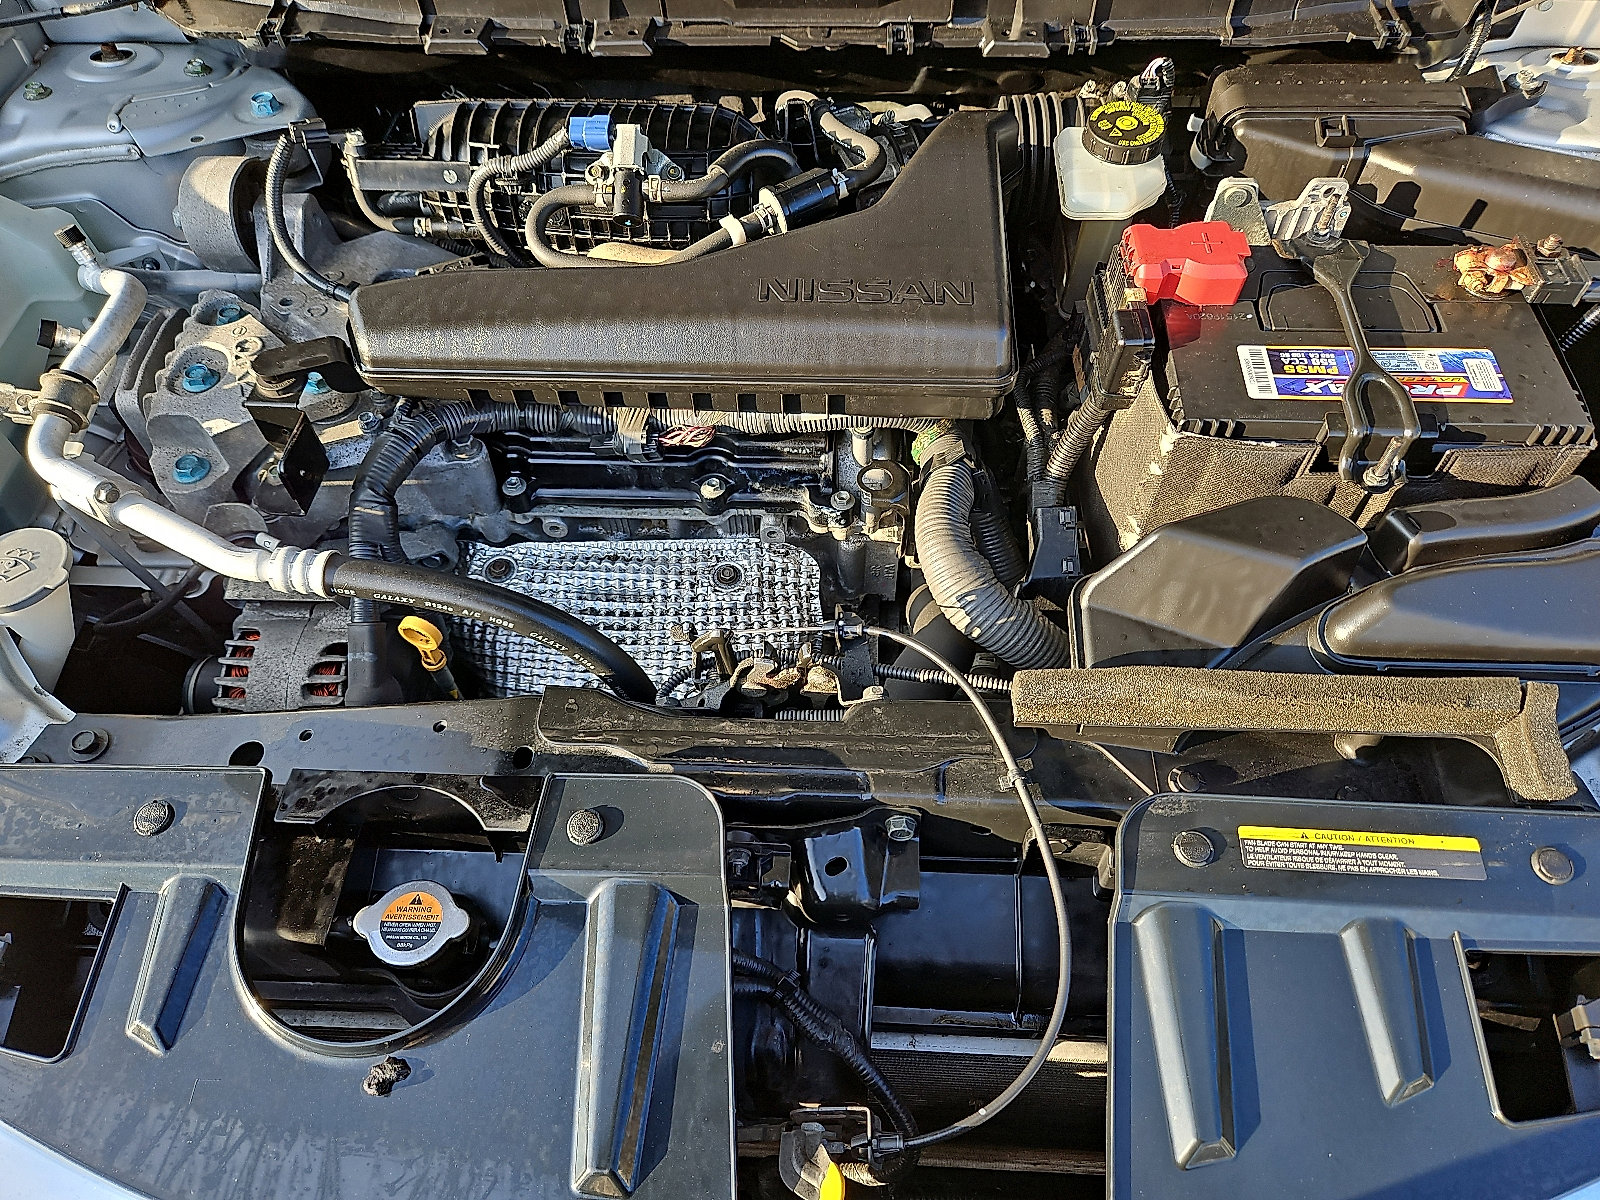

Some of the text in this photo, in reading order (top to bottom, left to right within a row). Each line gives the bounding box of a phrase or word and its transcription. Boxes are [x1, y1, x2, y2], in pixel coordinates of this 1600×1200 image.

[757, 277, 976, 306] NISSAN
[1280, 357, 1309, 366] CCA
[1282, 364, 1339, 375] PM35
[1299, 379, 1464, 396] PRAX
[373, 593, 416, 604] GALAXY
[462, 609, 481, 618] A/C
[489, 616, 515, 629] HOSE
[1314, 832, 1355, 842] CAUTION
[1365, 835, 1415, 845] ATTENTION
[1255, 846, 1270, 854] HELP
[396, 905, 433, 913] WARNING
[384, 913, 440, 921] AVERTISSEMENT
